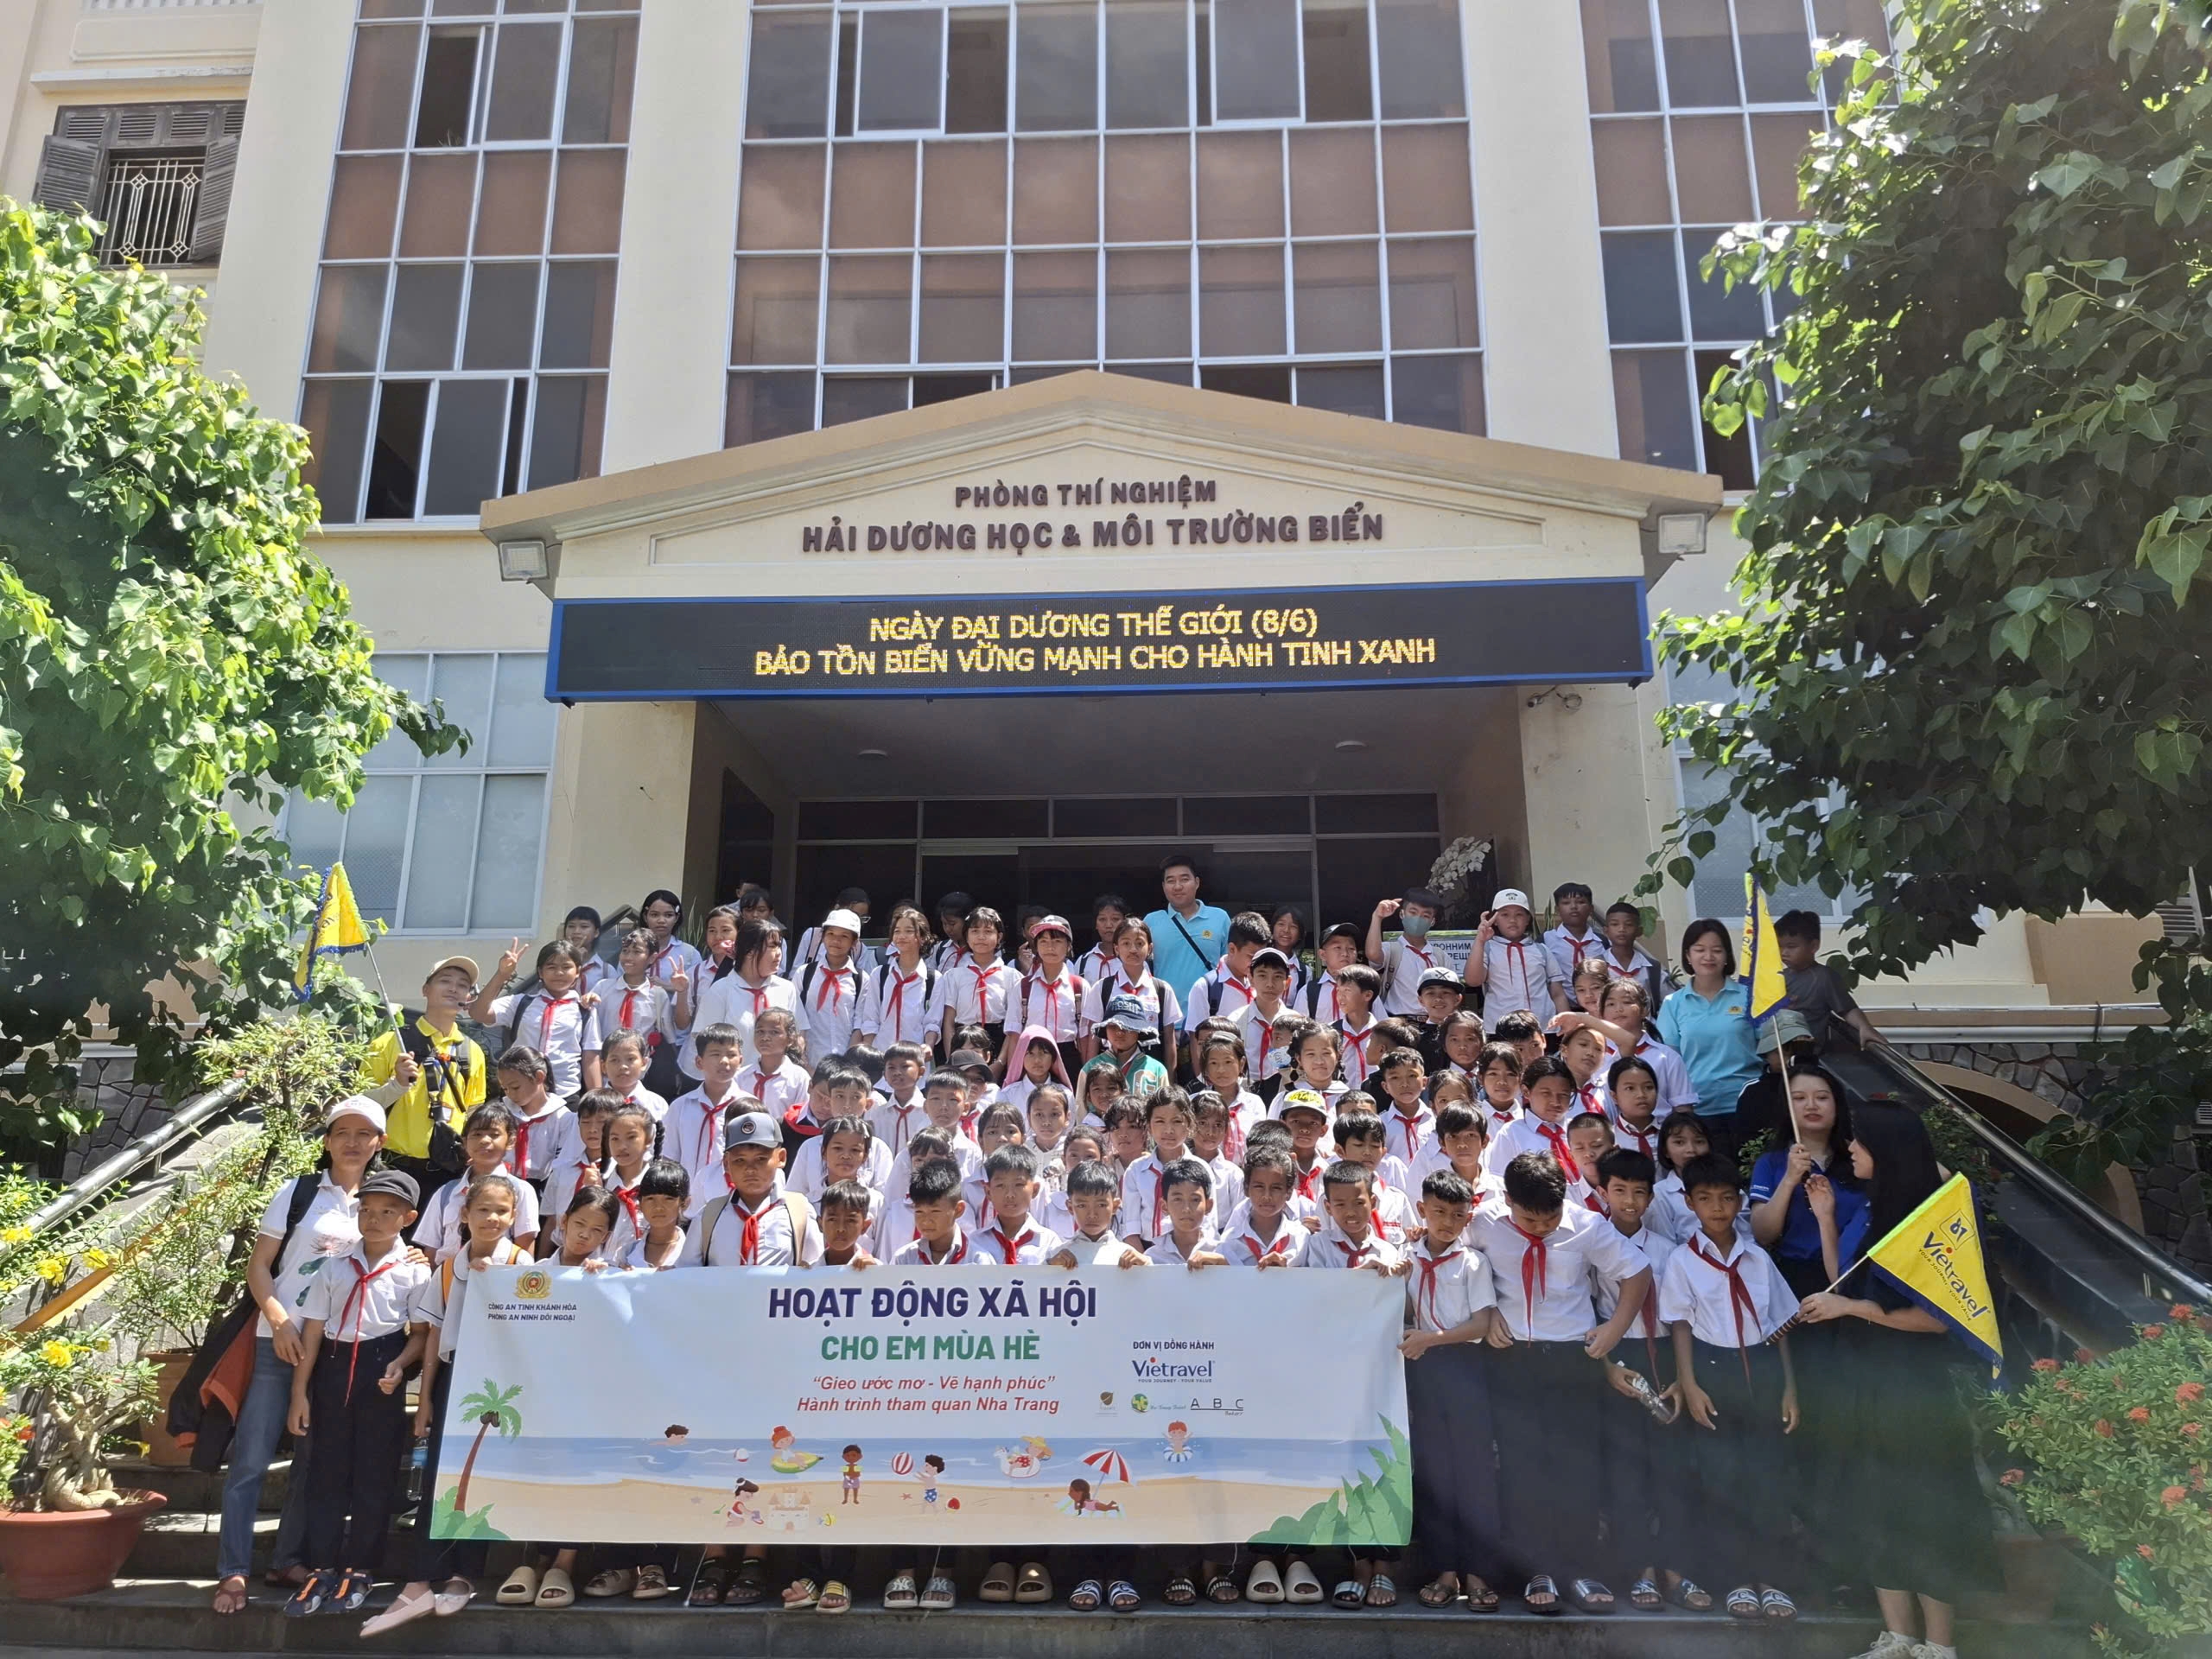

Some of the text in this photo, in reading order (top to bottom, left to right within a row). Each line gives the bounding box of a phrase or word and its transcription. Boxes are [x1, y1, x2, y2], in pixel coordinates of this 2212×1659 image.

[956, 474, 1217, 510] PHÒNG THÍ NGHIỆM
[802, 501, 1382, 556] HẢI DƯƠNG HỌC & MÔI TRƯỜNG BIỂN
[869, 610, 944, 642] NGÀY
[1008, 610, 1110, 639] DƯƠNG
[1116, 605, 1174, 637] THẾ
[1178, 603, 1243, 635] GIỚI
[1250, 607, 1319, 639] (8/6)
[754, 637, 1436, 676] BẢO TỒN BIỂN VỮNG MẠNH CHO HÀNH TINH XANH
[1923, 1230, 1988, 1318] Vietravel
[768, 1279, 1096, 1327] HOẠT ĐỘNG XÃ HỘI
[821, 1329, 1040, 1361] CHO EM MÙA HÈ
[1133, 1340, 1151, 1350] ĐƠN
[1154, 1341, 1162, 1351] VỊ
[1189, 1339, 1215, 1350] HÀNH
[812, 1376, 857, 1390] “Gieo
[861, 1375, 893, 1390] ước
[898, 1378, 925, 1390] mơ
[939, 1376, 958, 1390] Vẽ
[963, 1376, 1002, 1394] hạnh
[1131, 1357, 1212, 1377] Vietravel
[797, 1396, 1059, 1414] Hành trình tham quan Nha Trang
